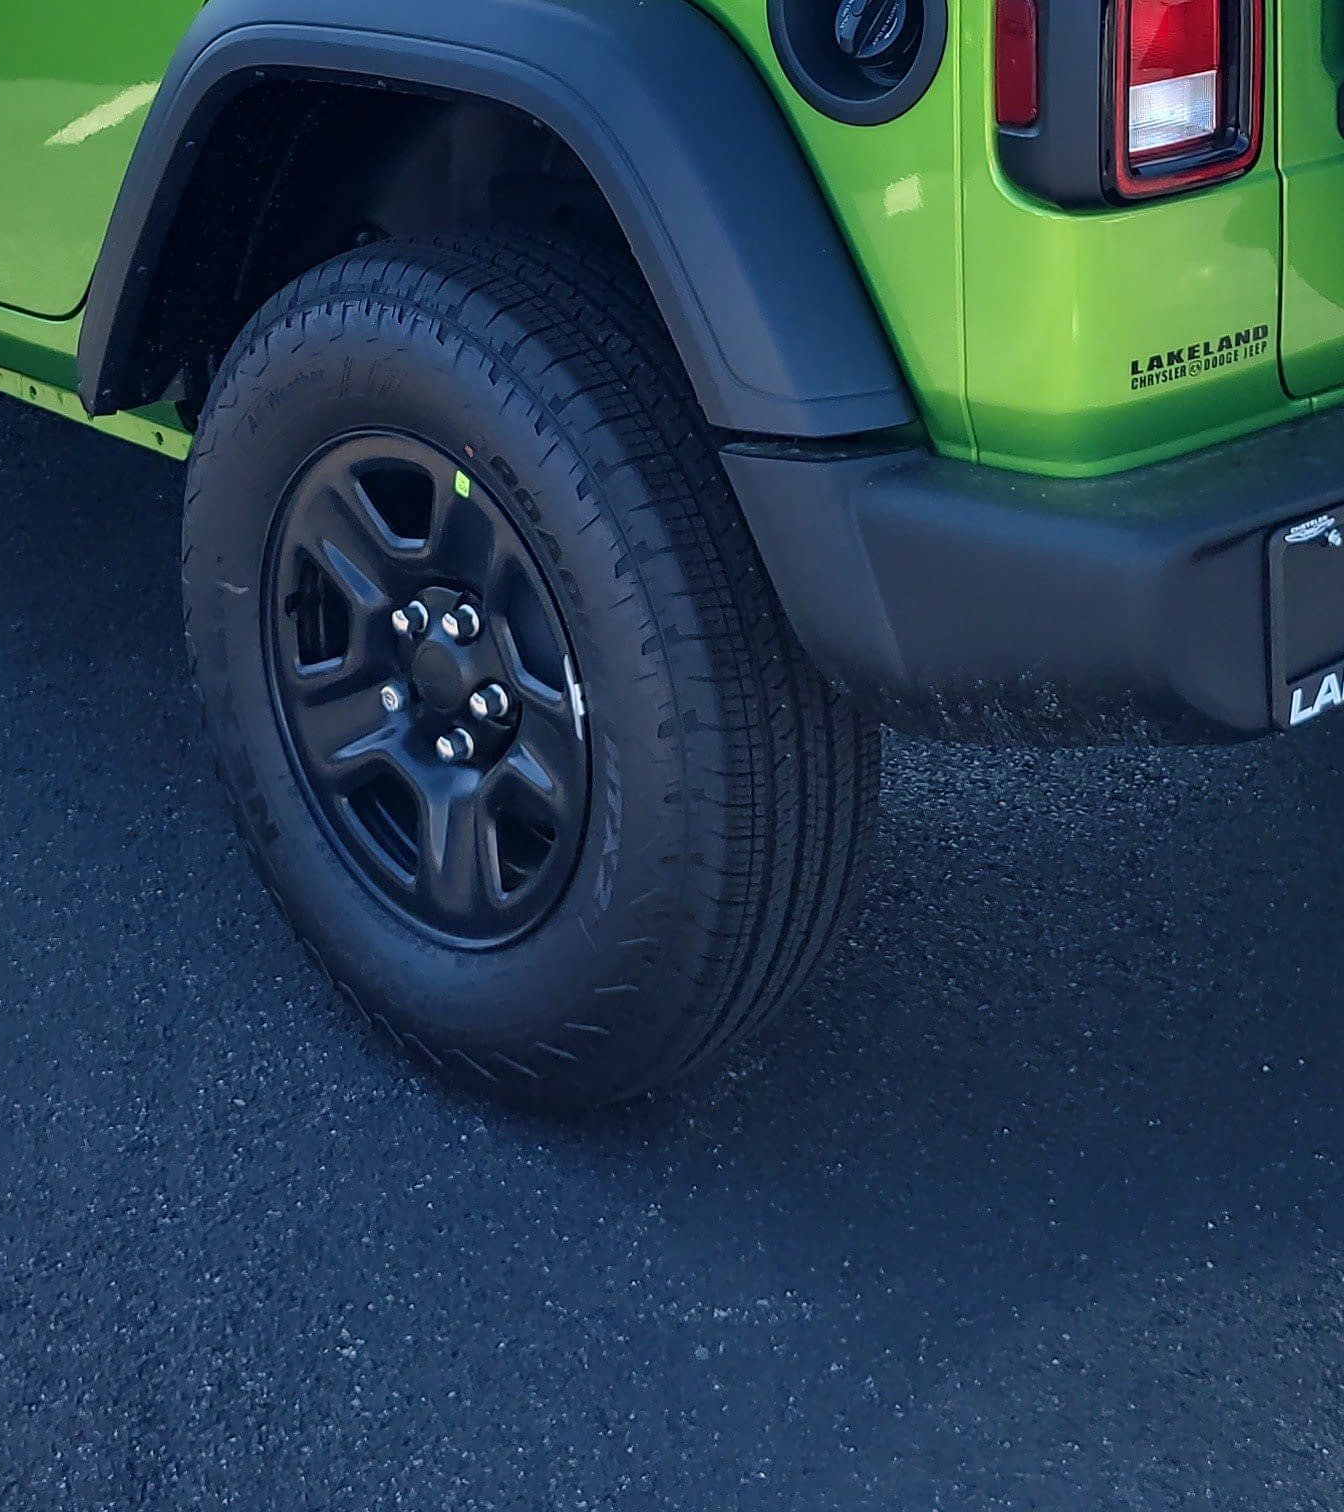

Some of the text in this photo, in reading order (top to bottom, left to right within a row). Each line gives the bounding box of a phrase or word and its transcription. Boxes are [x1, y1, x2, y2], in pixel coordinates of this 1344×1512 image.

[1130, 324, 1269, 376] LAKELAND
[1130, 340, 1268, 391] CHRYSLER DODGE JEEP
[1289, 514, 1329, 534] CHRYSLER
